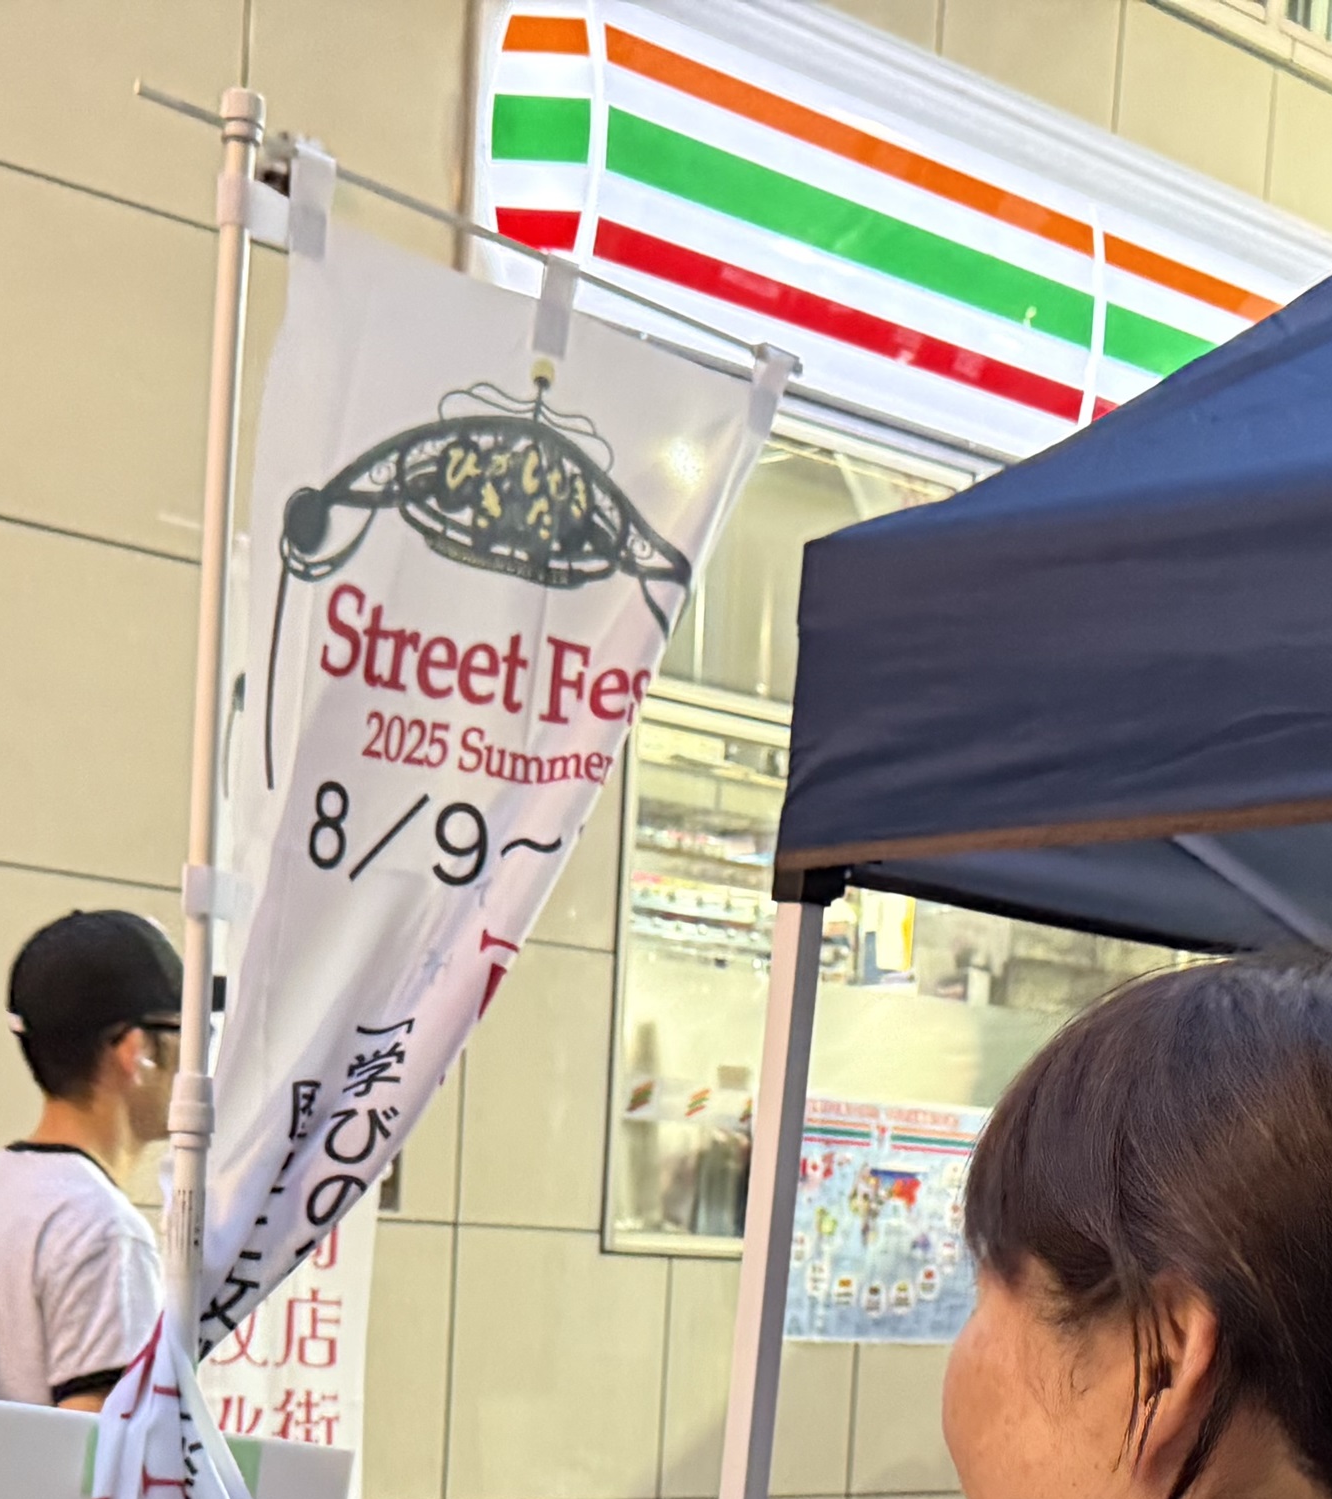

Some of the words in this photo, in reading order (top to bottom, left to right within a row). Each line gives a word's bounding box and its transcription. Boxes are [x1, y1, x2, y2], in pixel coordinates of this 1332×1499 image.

[319, 583, 528, 713] Street
[361, 711, 450, 768] 2025
[457, 726, 613, 786] Summer
[273, 1224, 343, 1446] 店街
